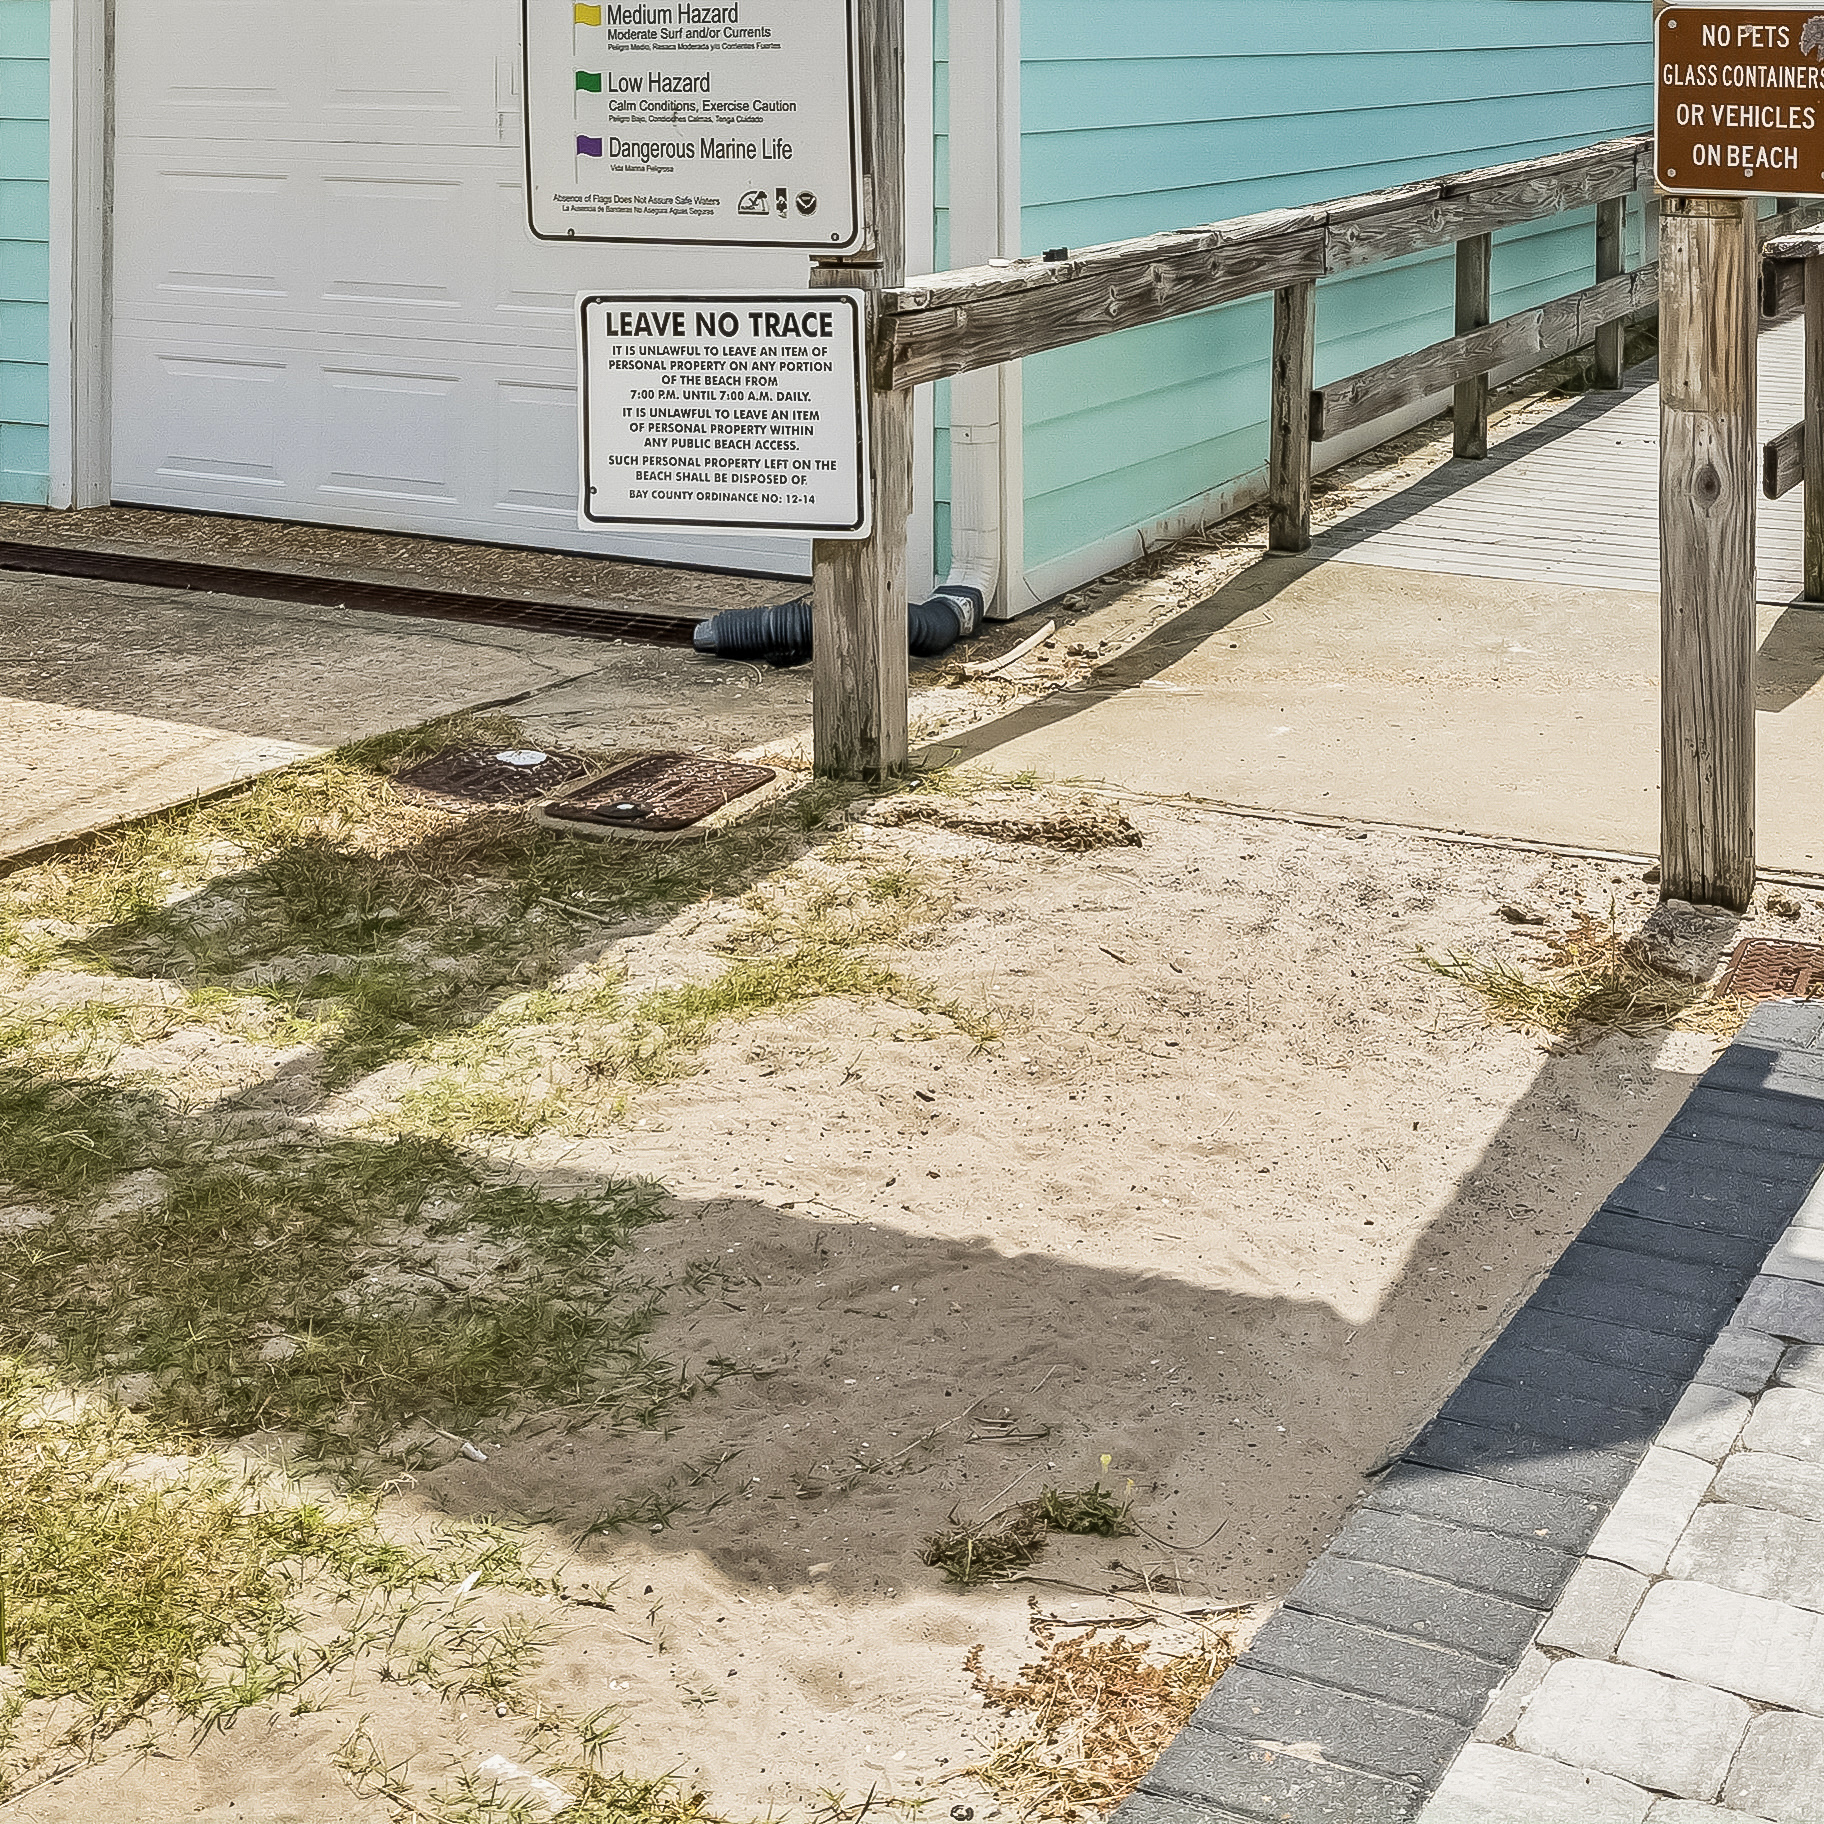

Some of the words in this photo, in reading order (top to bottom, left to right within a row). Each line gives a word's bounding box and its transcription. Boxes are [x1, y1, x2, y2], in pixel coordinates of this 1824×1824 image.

[608, 4, 672, 25] Medium
[678, 2, 738, 24] Hazard
[608, 29, 657, 40] Moderate
[661, 28, 682, 39] Surf
[686, 28, 720, 38] and/or
[724, 27, 771, 38] Currents
[1702, 25, 1730, 47] NO
[1737, 25, 1789, 48] PETS
[609, 72, 643, 92] Low
[649, 72, 710, 92] Hazard
[1663, 65, 1718, 87] GLASS
[609, 100, 636, 111] Calm
[639, 100, 699, 112] Conditions,
[703, 100, 749, 111] Exercise
[753, 100, 796, 111] Caution
[1677, 104, 1704, 125] OR
[1712, 105, 1815, 128] VEHICLES
[610, 137, 695, 163] Dangerous
[701, 138, 756, 159] Marine
[763, 138, 792, 159] Life
[1693, 144, 1721, 166] ON
[1727, 146, 1797, 169] BEACH
[607, 312, 685, 336] LEAVE
[696, 312, 738, 337] NO
[749, 312, 832, 337] TRACE
[613, 346, 621, 355] IT
[626, 346, 635, 355] IS
[639, 346, 700, 356] UNLAWFUL
[704, 347, 718, 356] TO
[723, 347, 756, 356] LEAVE
[760, 347, 777, 356] AN
[782, 347, 808, 356] ITEM
[812, 347, 827, 356] OF
[609, 360, 666, 370] PERSONAL
[671, 361, 726, 370] PROPERTY
[730, 361, 747, 371] ON
[752, 362, 776, 371] ANY
[780, 362, 832, 371] PORTION
[662, 375, 676, 384] OF
[680, 376, 701, 385] THE
[705, 376, 741, 385] BEACH
[746, 377, 778, 386] FROM
[631, 390, 654, 399] 7:00
[659, 391, 679, 399] P.M.
[683, 391, 716, 400] UNTIL
[720, 391, 744, 400] 7:00
[748, 392, 772, 401] A.M.
[777, 392, 811, 401] DAILY.
[623, 408, 632, 417] IT
[636, 408, 646, 417] IS
[650, 408, 711, 418] UNLAWFUL
[715, 409, 729, 419] TO
[734, 410, 767, 419] LEAVE
[771, 410, 788, 420] AN
[793, 411, 819, 420] ITEM
[630, 423, 644, 432] OF
[649, 423, 707, 433] PERSONAL
[711, 424, 767, 434] PROPERTY
[770, 426, 813, 435] WITHIN
[644, 438, 667, 447] ANY
[672, 438, 710, 448] PUBLIC
[715, 440, 750, 449] BEACH
[755, 440, 799, 450] ACCESS.
[609, 456, 638, 465] SUCH
[643, 456, 701, 467] PERSONAL
[705, 458, 760, 468] PROPERTY
[765, 459, 788, 469] LEFT
[793, 460, 811, 470] ON
[815, 460, 836, 470] THE
[636, 471, 671, 480] BEACH
[676, 472, 710, 482] SHALL
[715, 473, 727, 482] BE
[732, 474, 787, 484] DISPOSED
[630, 490, 648, 498] BAY
[652, 491, 693, 500] COUNTY
[697, 492, 758, 502] ORDINANCE
[762, 494, 782, 503] NO:
[787, 495, 814, 504] 12-14
